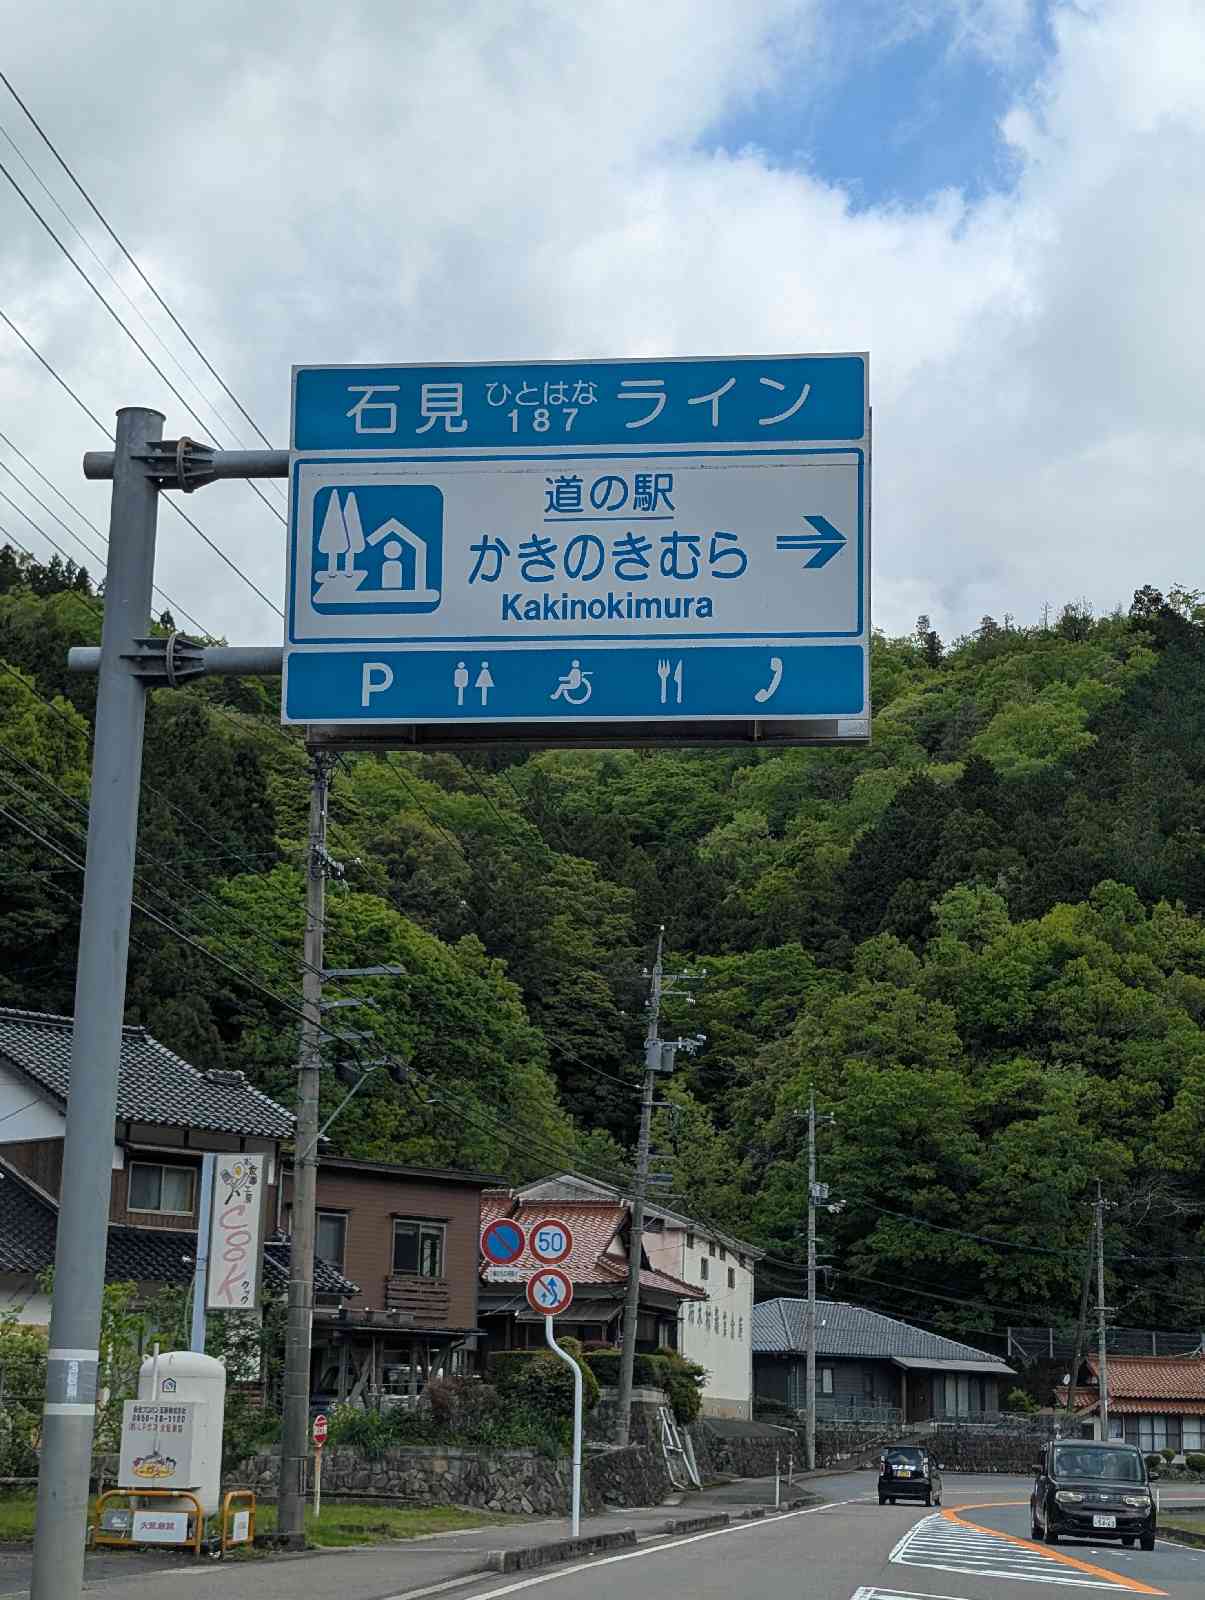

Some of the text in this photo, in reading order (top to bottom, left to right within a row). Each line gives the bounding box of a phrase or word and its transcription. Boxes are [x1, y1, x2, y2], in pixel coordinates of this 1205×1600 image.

[346, 377, 811, 434] 石見 187 ライン
[486, 380, 598, 406] ひとはな
[544, 473, 676, 514] 道の駅
[468, 530, 748, 585] かきのきむら
[501, 591, 713, 621] Kakinokimura
[361, 662, 394, 707] P
[538, 1231, 563, 1253] 50
